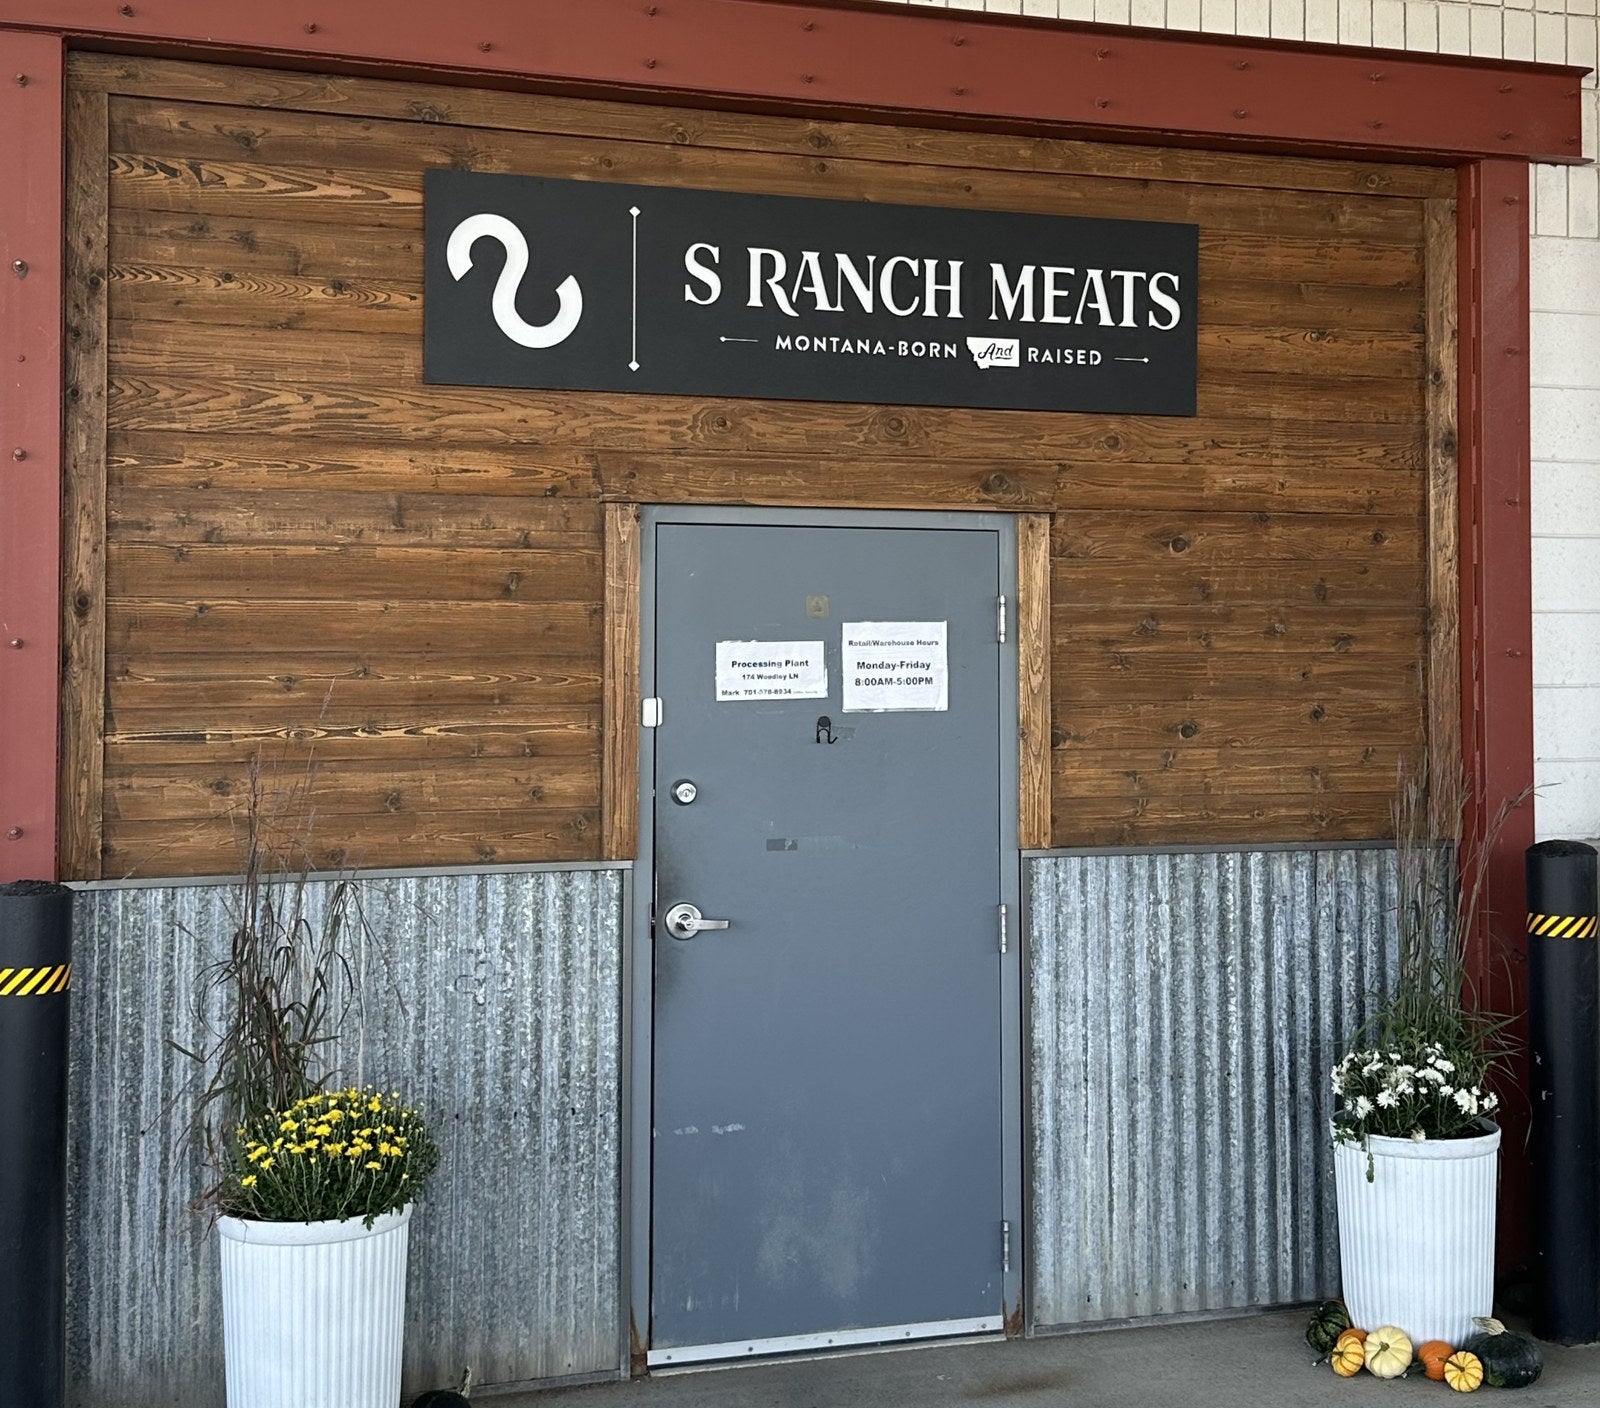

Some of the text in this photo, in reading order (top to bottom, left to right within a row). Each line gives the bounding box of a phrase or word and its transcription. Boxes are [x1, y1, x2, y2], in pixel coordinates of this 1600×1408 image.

[684, 242, 1181, 331] S RANCH MEATS
[775, 334, 1102, 366] MONTANA-BORN And RAISED
[731, 659, 809, 669] Processing Plant
[856, 660, 931, 671] Monday-Friday
[854, 676, 934, 687] 8:00AM-5:00PM
[721, 689, 740, 697] Mark
